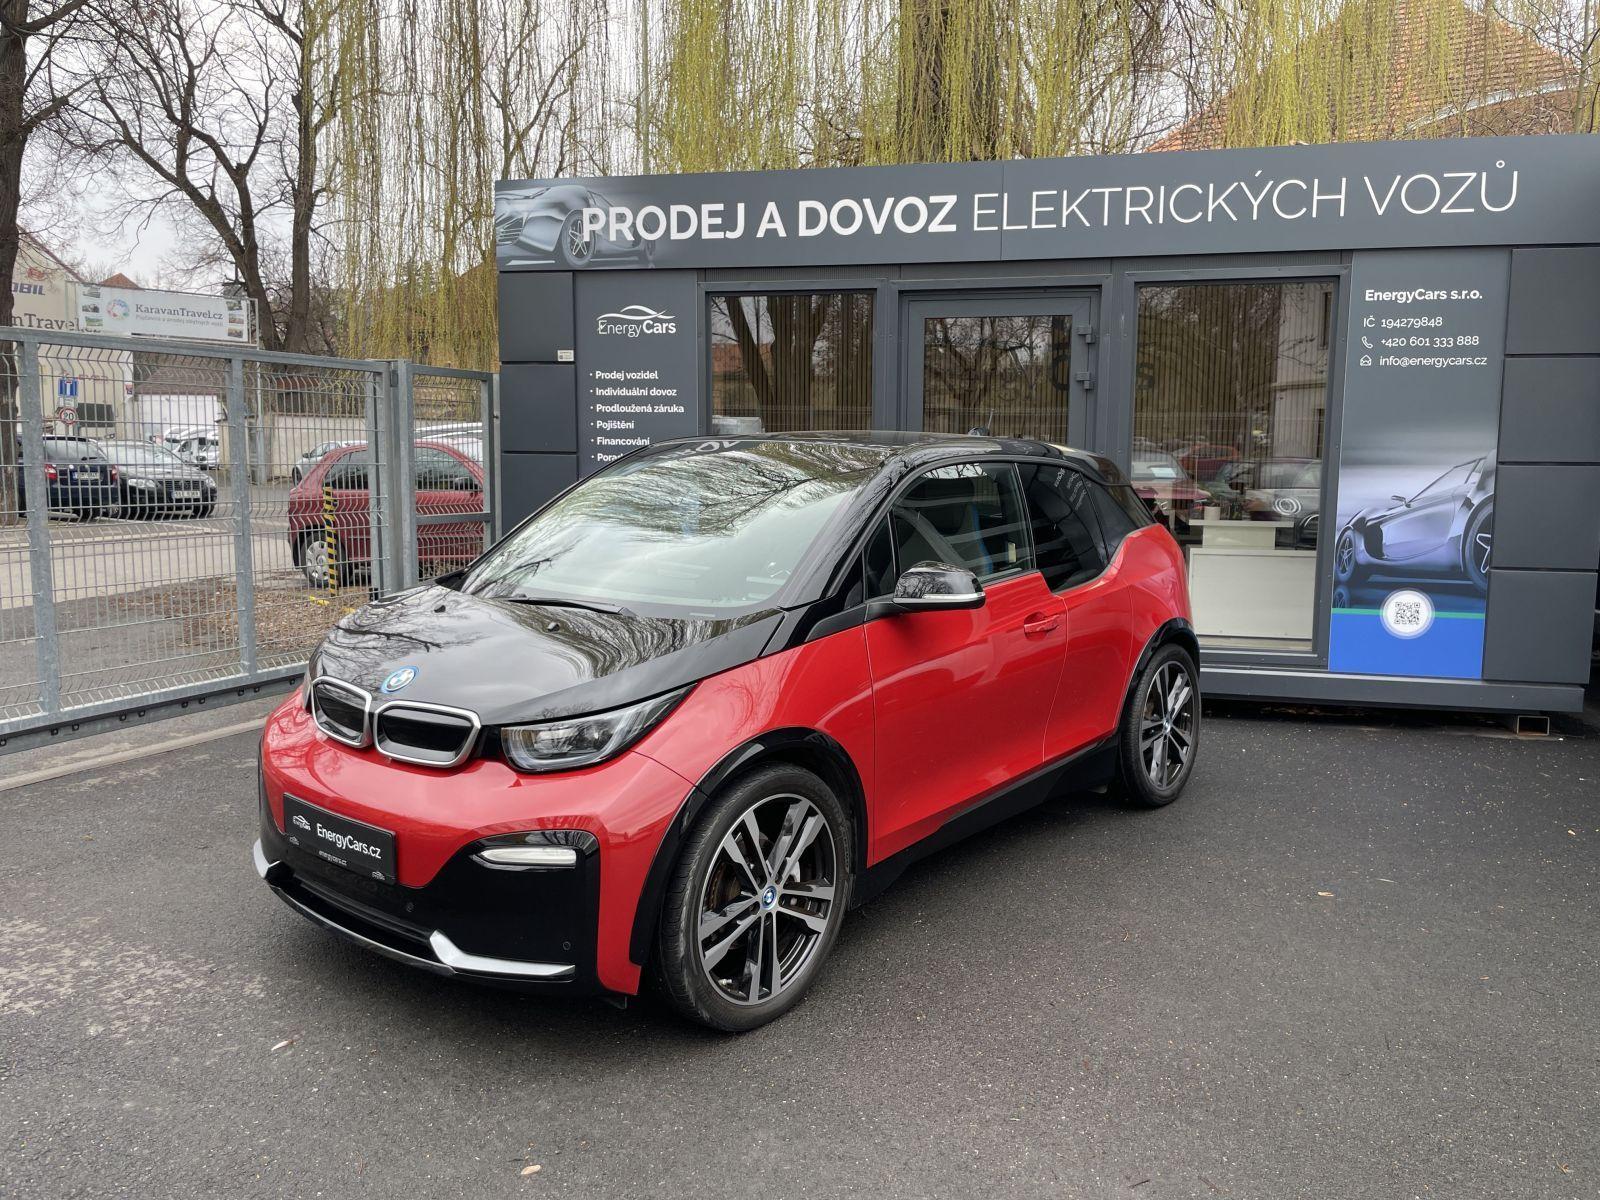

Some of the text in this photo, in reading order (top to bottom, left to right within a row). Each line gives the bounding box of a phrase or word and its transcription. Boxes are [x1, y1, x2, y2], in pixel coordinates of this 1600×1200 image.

[582, 159, 1519, 242] PRODEJ A DOVOZ ELEKTRICKÝCH VOZŮ
[1365, 288, 1483, 304] EnergyCars s.r.o.
[135, 303, 224, 320] KaravanTravel.cz
[1363, 315, 1443, 329] IČ 194279848
[1380, 335, 1480, 348] +420 601 333 888
[1379, 355, 1488, 368] info@energycars.cz
[595, 370, 659, 381] Prodej vozidel
[595, 386, 677, 396] Individuální dovoz
[596, 403, 685, 413] Prodloužená záruka
[596, 419, 635, 431] Pojištění
[596, 436, 650, 446] Financování
[316, 823, 382, 860] EnergyCars.cz
